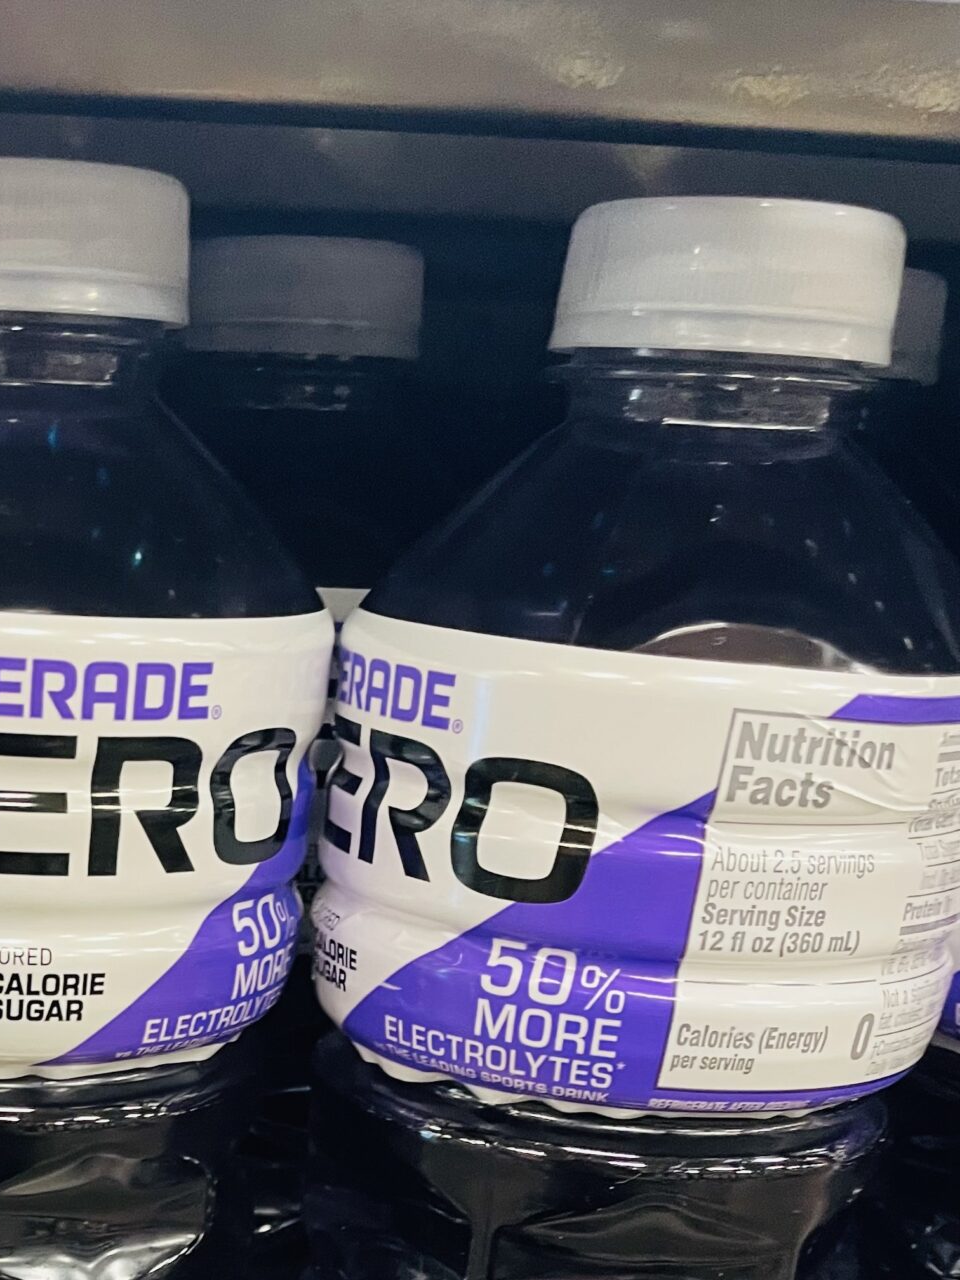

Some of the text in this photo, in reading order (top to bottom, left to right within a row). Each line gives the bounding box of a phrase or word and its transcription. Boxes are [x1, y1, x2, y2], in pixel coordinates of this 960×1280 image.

[734, 720, 895, 771] Nutrition
[724, 765, 834, 809] Facts
[711, 846, 875, 879] About 2.5 servings
[706, 876, 827, 904] per container
[701, 902, 827, 931] Serving Size
[698, 928, 861, 957] 12 fl oz (360 mL)
[480, 937, 626, 1016] 50%
[473, 998, 622, 1059] MORE
[676, 1022, 755, 1051] Calories
[759, 1025, 829, 1054] (Energy)
[850, 1012, 876, 1061] 0
[412, 1053, 609, 1103] LEADING SPORTS DRINK
[670, 1054, 755, 1075] per serving
